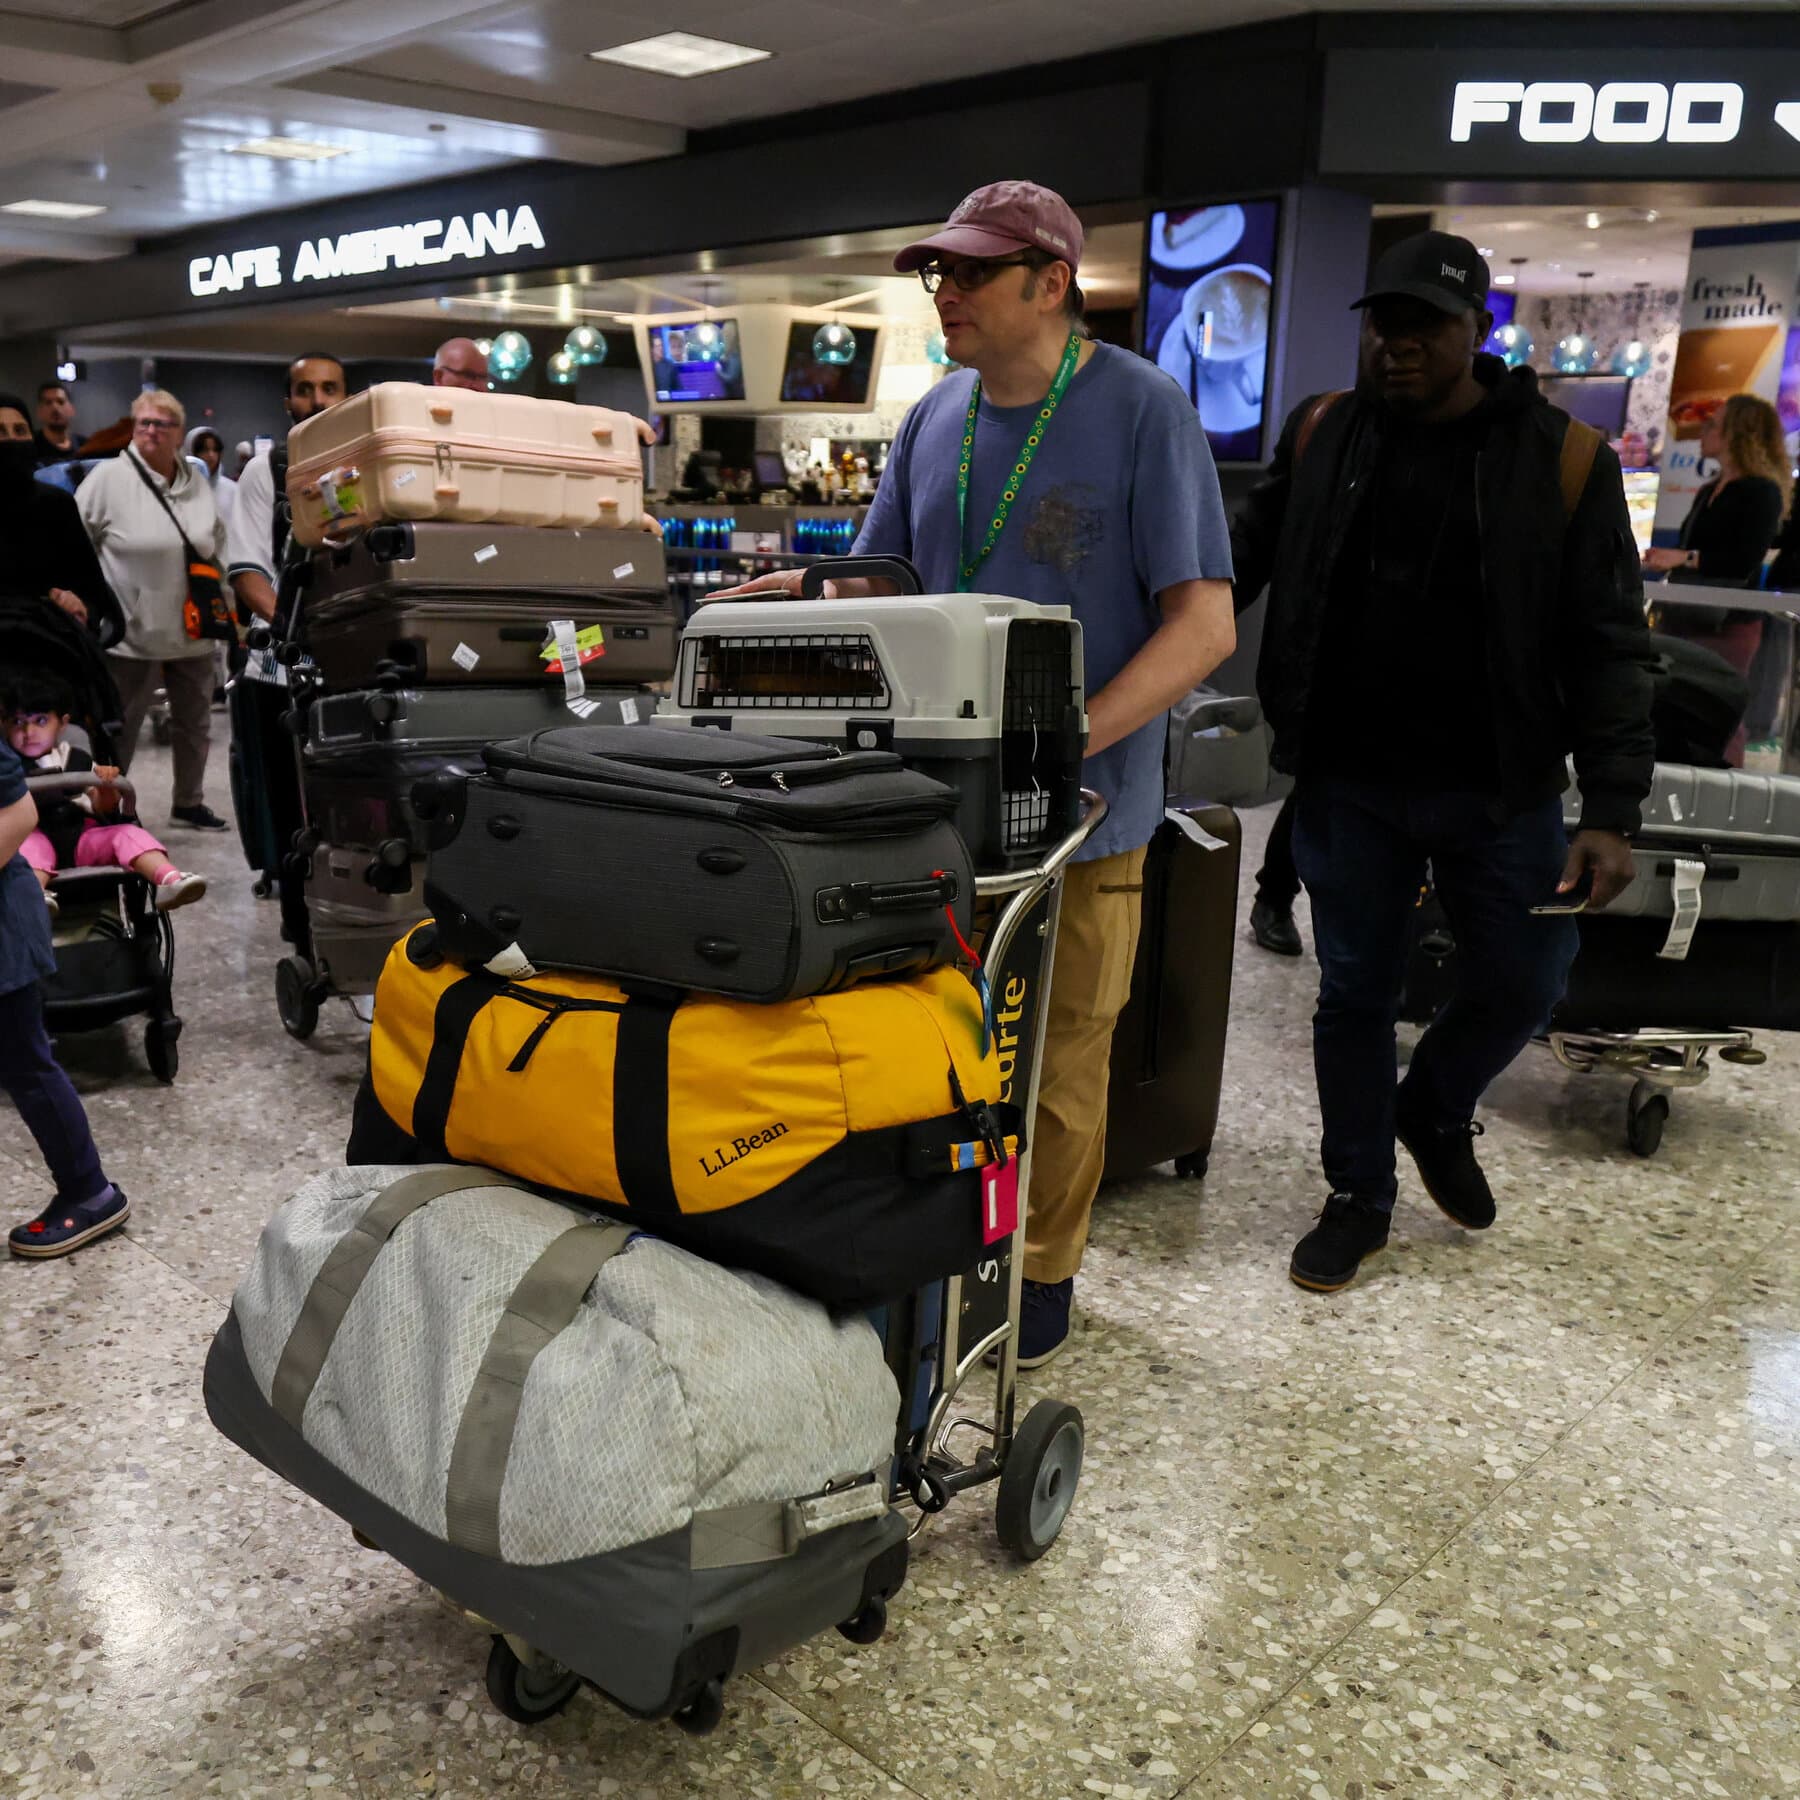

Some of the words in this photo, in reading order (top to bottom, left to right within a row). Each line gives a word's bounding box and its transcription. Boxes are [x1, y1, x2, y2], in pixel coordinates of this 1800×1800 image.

[1450, 82, 1744, 143] FOOD
[190, 246, 281, 296] CAFE
[293, 205, 545, 282] AMERICANA
[1692, 274, 1763, 301] fresh
[1704, 294, 1782, 319] made
[699, 1122, 789, 1177] L.L.Bean
